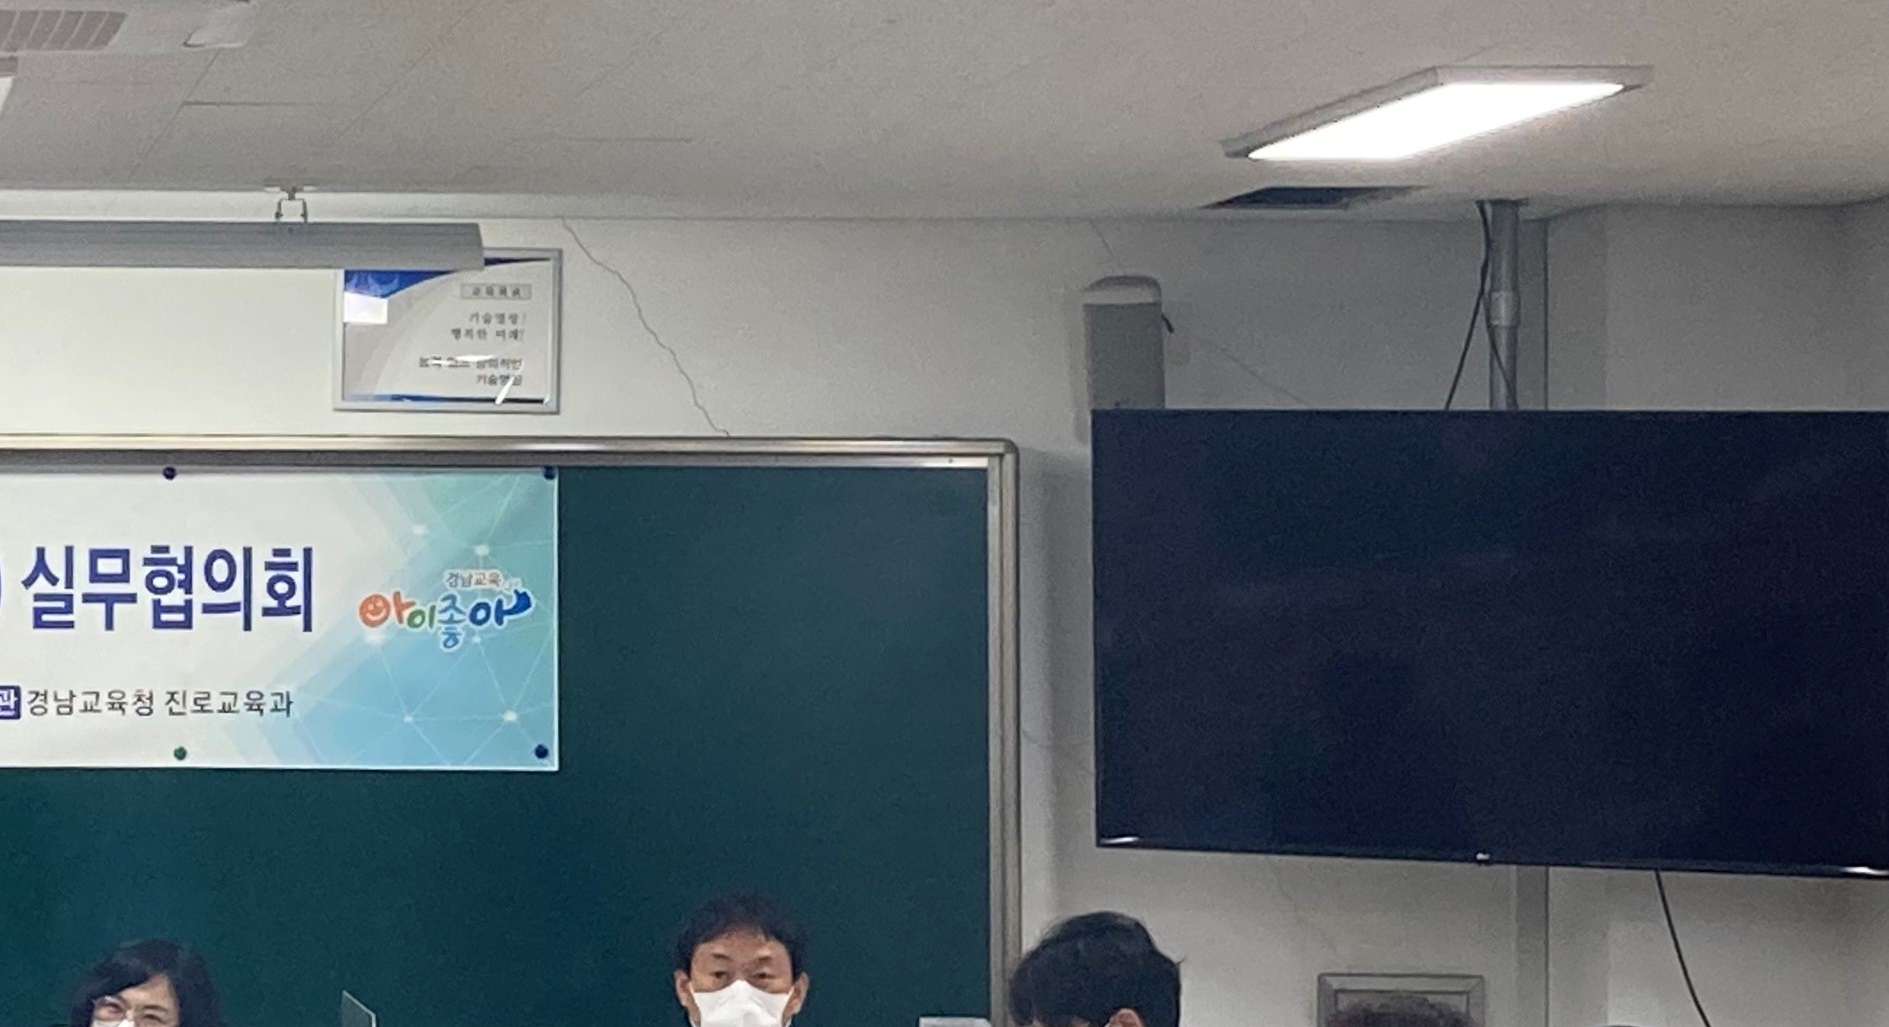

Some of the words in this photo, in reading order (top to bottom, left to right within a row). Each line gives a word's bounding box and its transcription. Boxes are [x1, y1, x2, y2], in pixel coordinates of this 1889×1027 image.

[21, 543, 313, 632] 실무협의회
[446, 572, 502, 588] 경남교육
[26, 689, 155, 718] 경남교육청
[164, 689, 295, 718] 진로교육과
